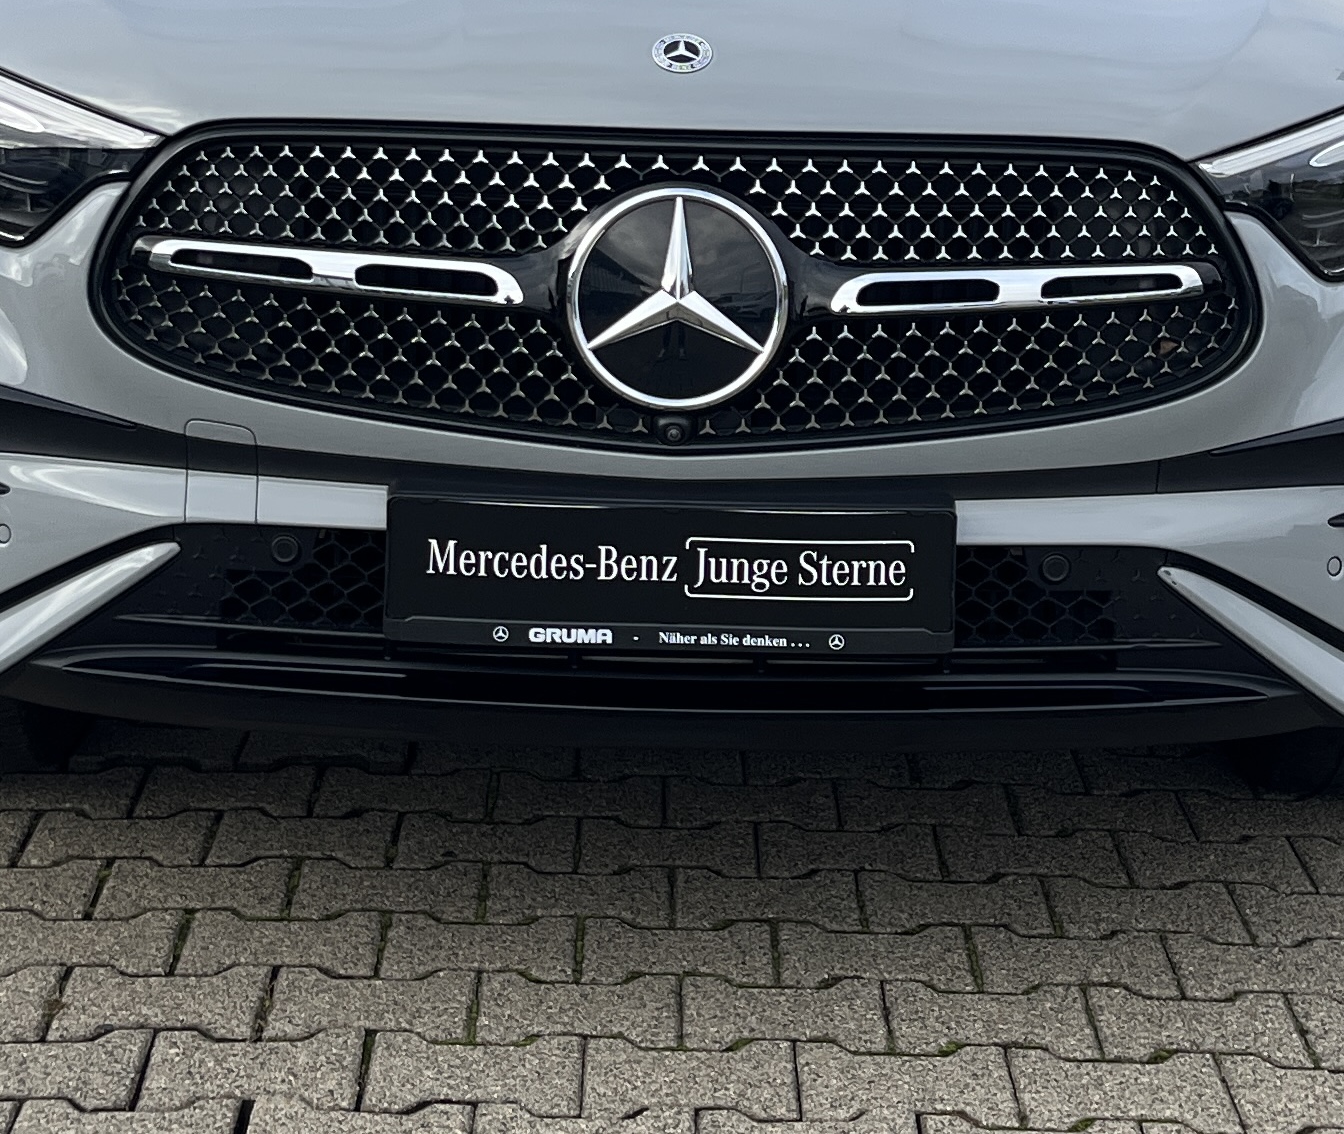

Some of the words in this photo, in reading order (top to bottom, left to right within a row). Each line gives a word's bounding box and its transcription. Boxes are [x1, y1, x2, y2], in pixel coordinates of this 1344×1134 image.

[426, 538, 678, 582] Mercedes-Benz
[693, 547, 788, 592] Junge
[798, 550, 906, 587] Sterne
[528, 627, 613, 644] GRUMA
[658, 631, 697, 645] Näher
[700, 633, 718, 645] als
[720, 633, 739, 646] Sie
[742, 634, 788, 647] denken
